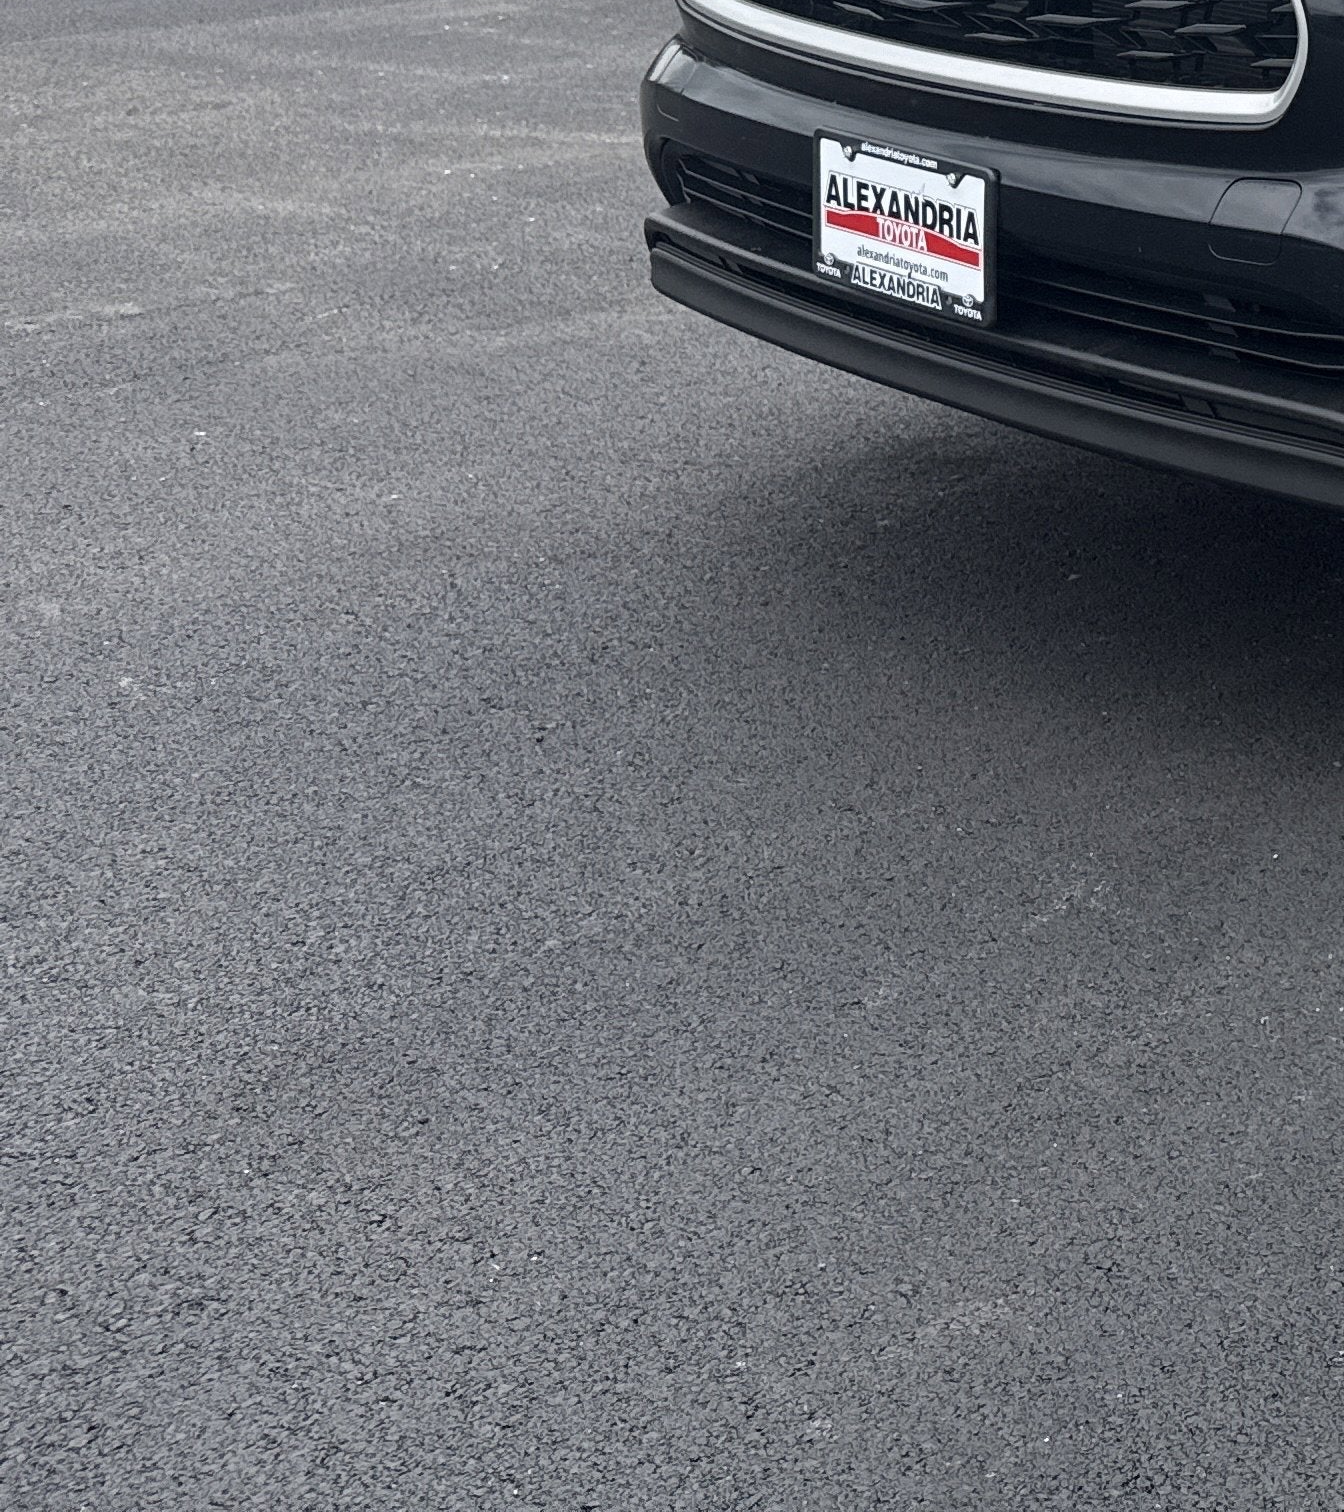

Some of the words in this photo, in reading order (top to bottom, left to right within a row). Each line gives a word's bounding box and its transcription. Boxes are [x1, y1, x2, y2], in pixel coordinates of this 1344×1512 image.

[826, 174, 979, 246] ALEXANDRIA
[877, 217, 928, 251] TOYOTA
[816, 262, 842, 278] TOYOTA
[857, 244, 949, 283] alexandriatoyota.com
[851, 263, 943, 310] ALEXANDRIA
[954, 304, 982, 321] TOYOTA
